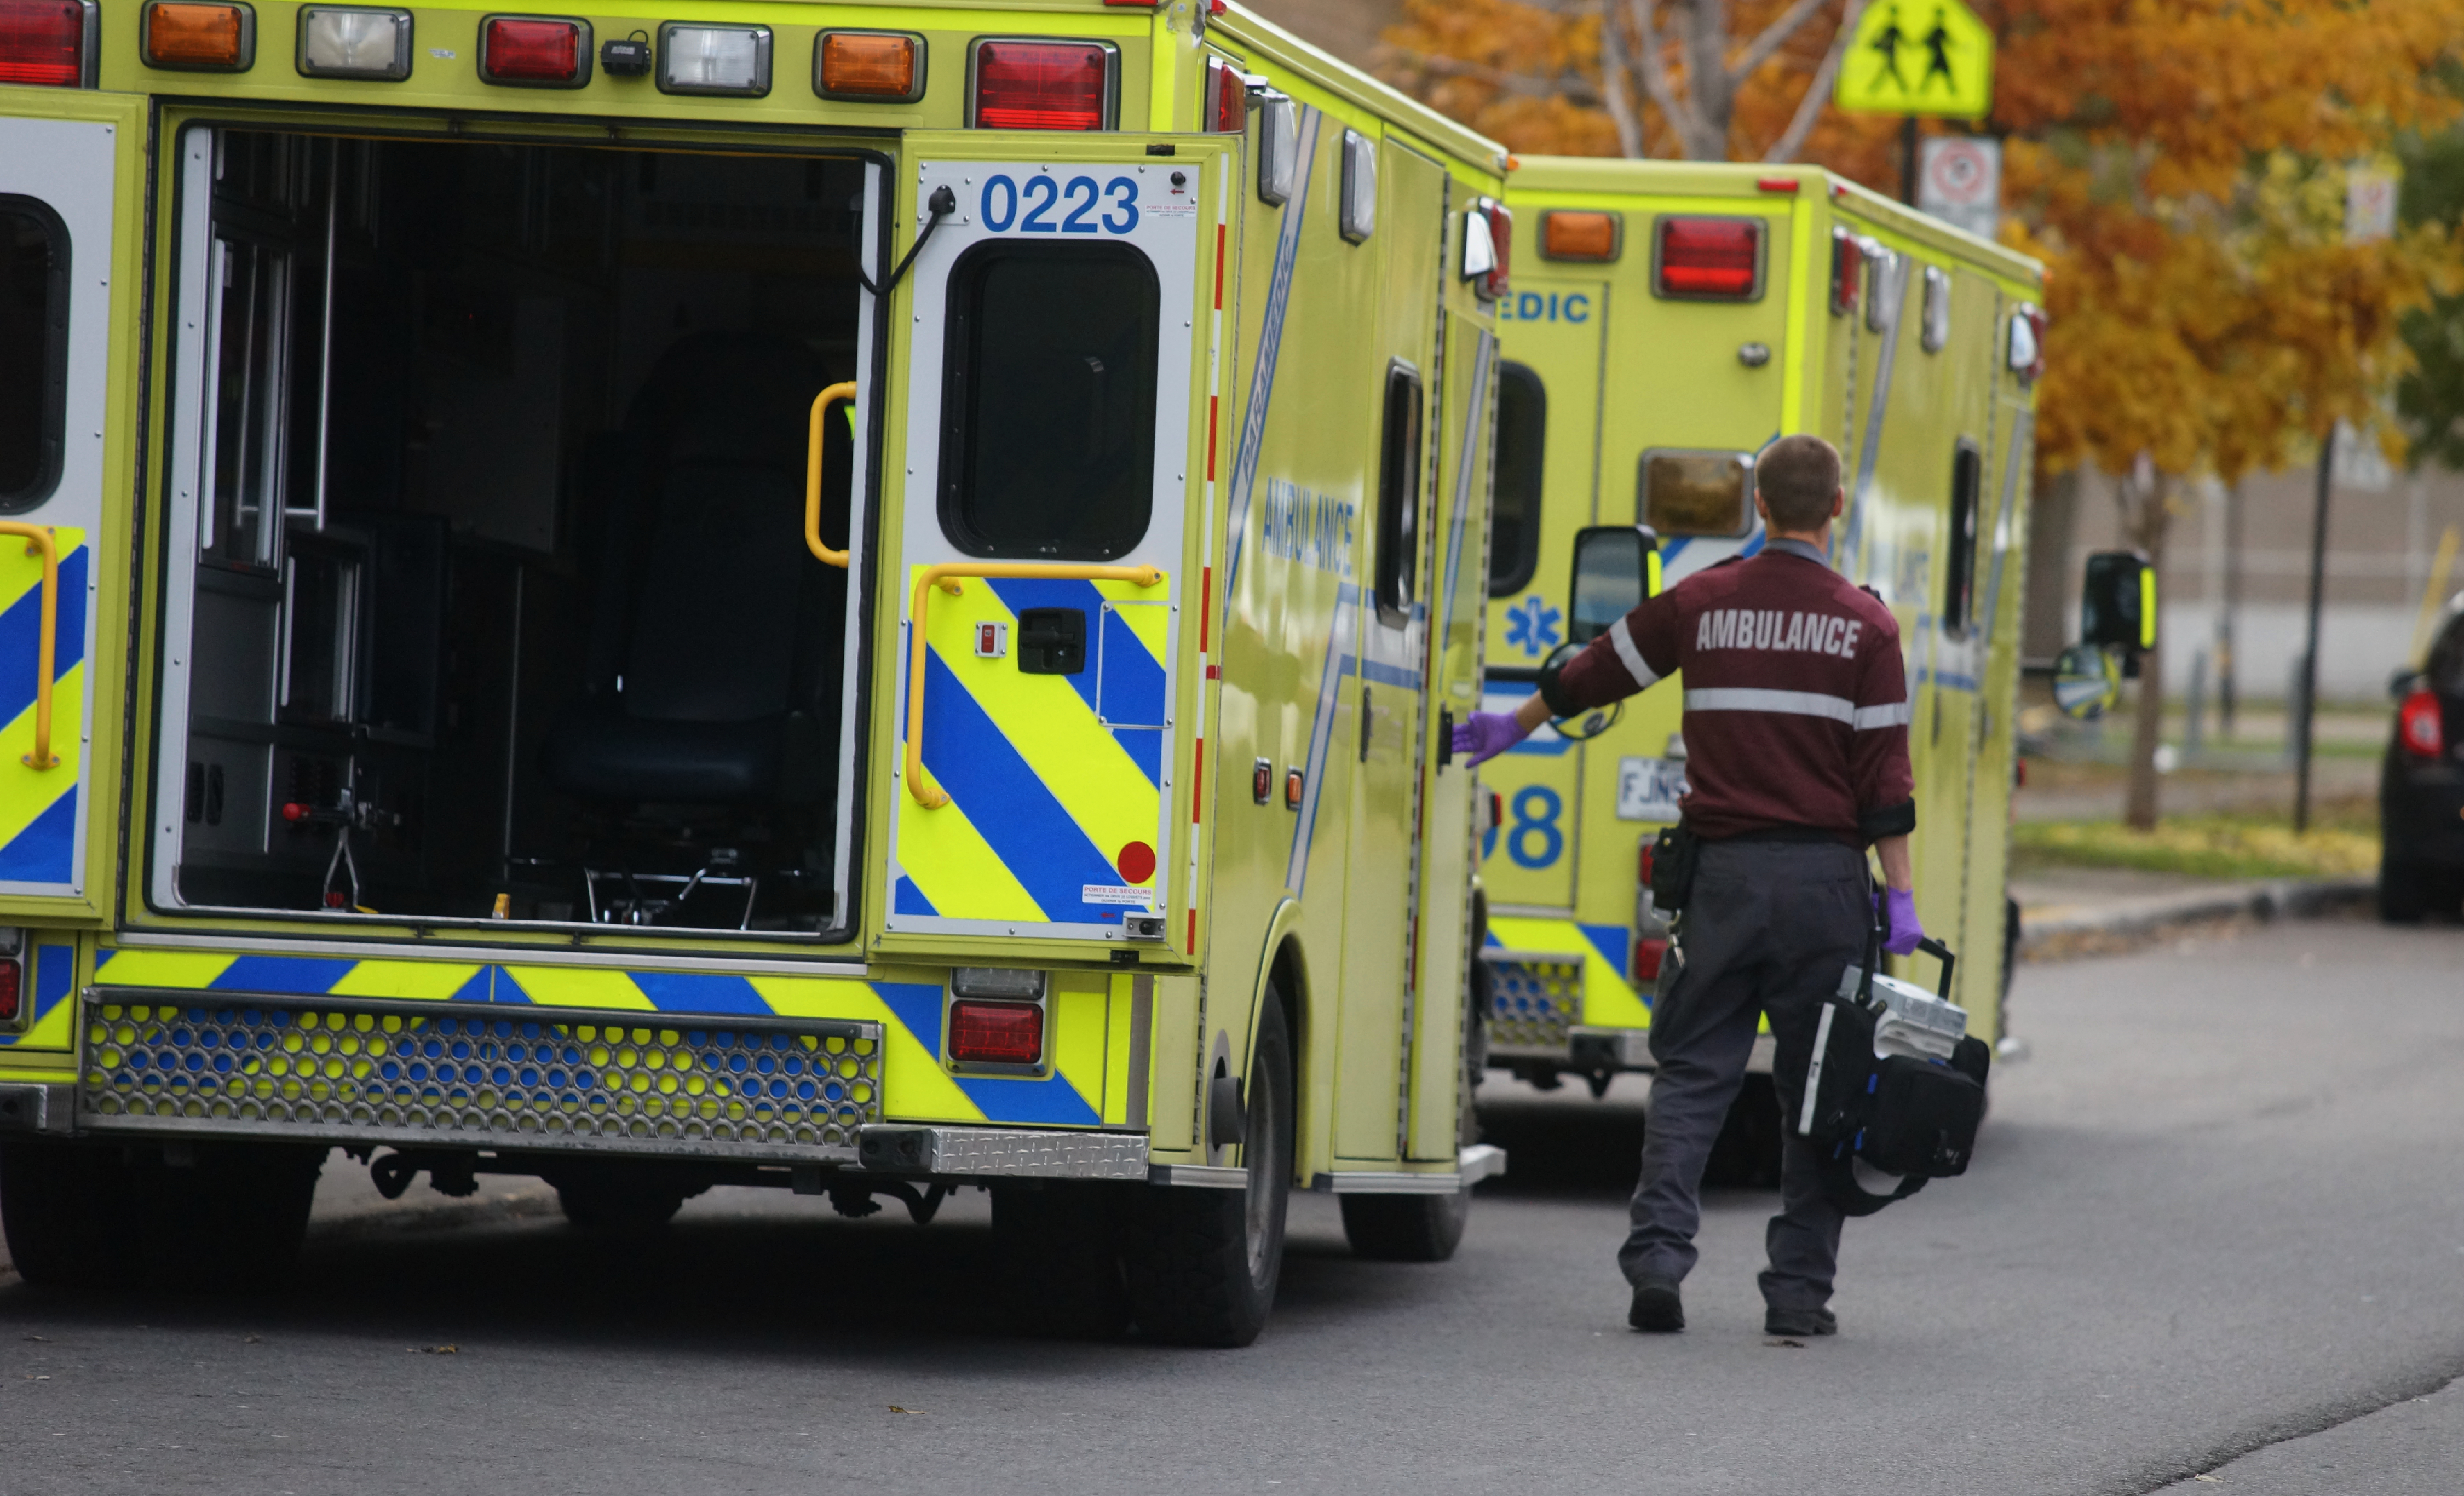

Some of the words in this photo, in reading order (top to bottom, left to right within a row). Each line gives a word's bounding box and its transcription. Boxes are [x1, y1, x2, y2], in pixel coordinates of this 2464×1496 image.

[981, 174, 1139, 234] 0223
[1261, 476, 1354, 577] AMBULANCE
[1696, 608, 1862, 659] AMBULANCE
[1482, 785, 1564, 870] 8
